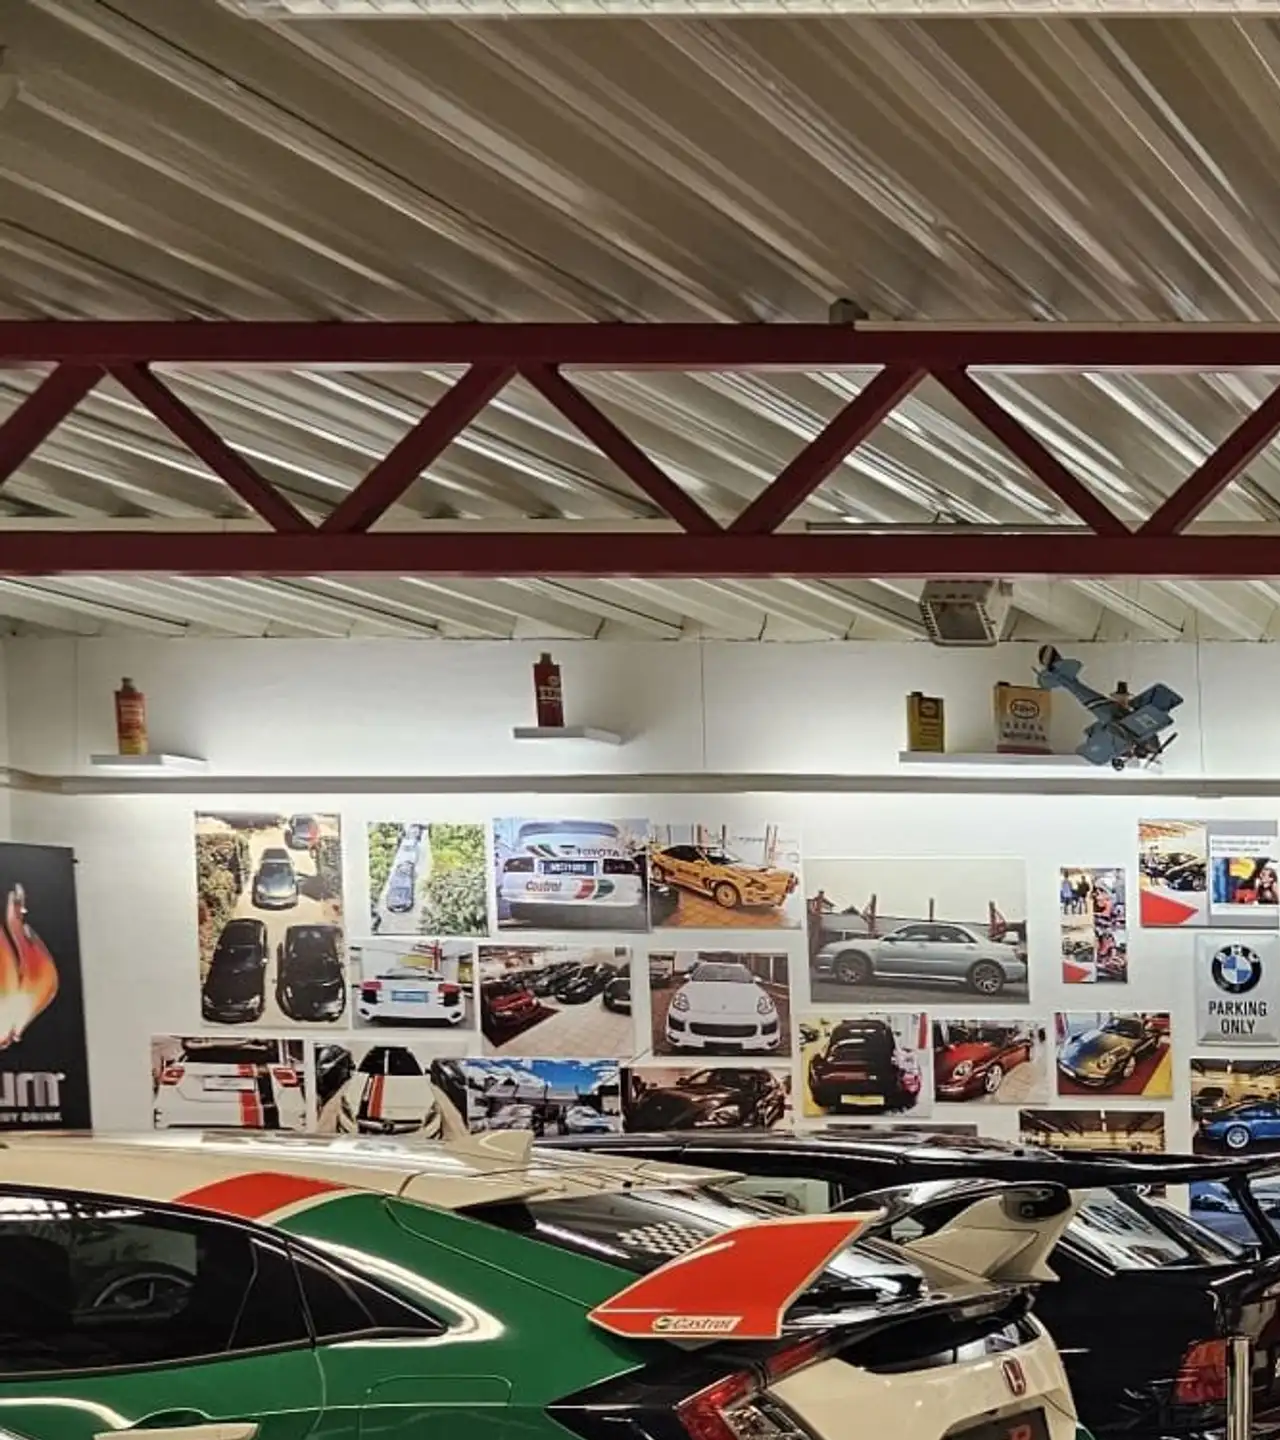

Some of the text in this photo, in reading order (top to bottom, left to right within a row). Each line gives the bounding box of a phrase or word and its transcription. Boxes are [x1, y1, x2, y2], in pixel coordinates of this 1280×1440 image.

[1208, 1000, 1268, 1017] PARKING
[1221, 1019, 1255, 1034] ONLY
[673, 1318, 734, 1331] Castrol
